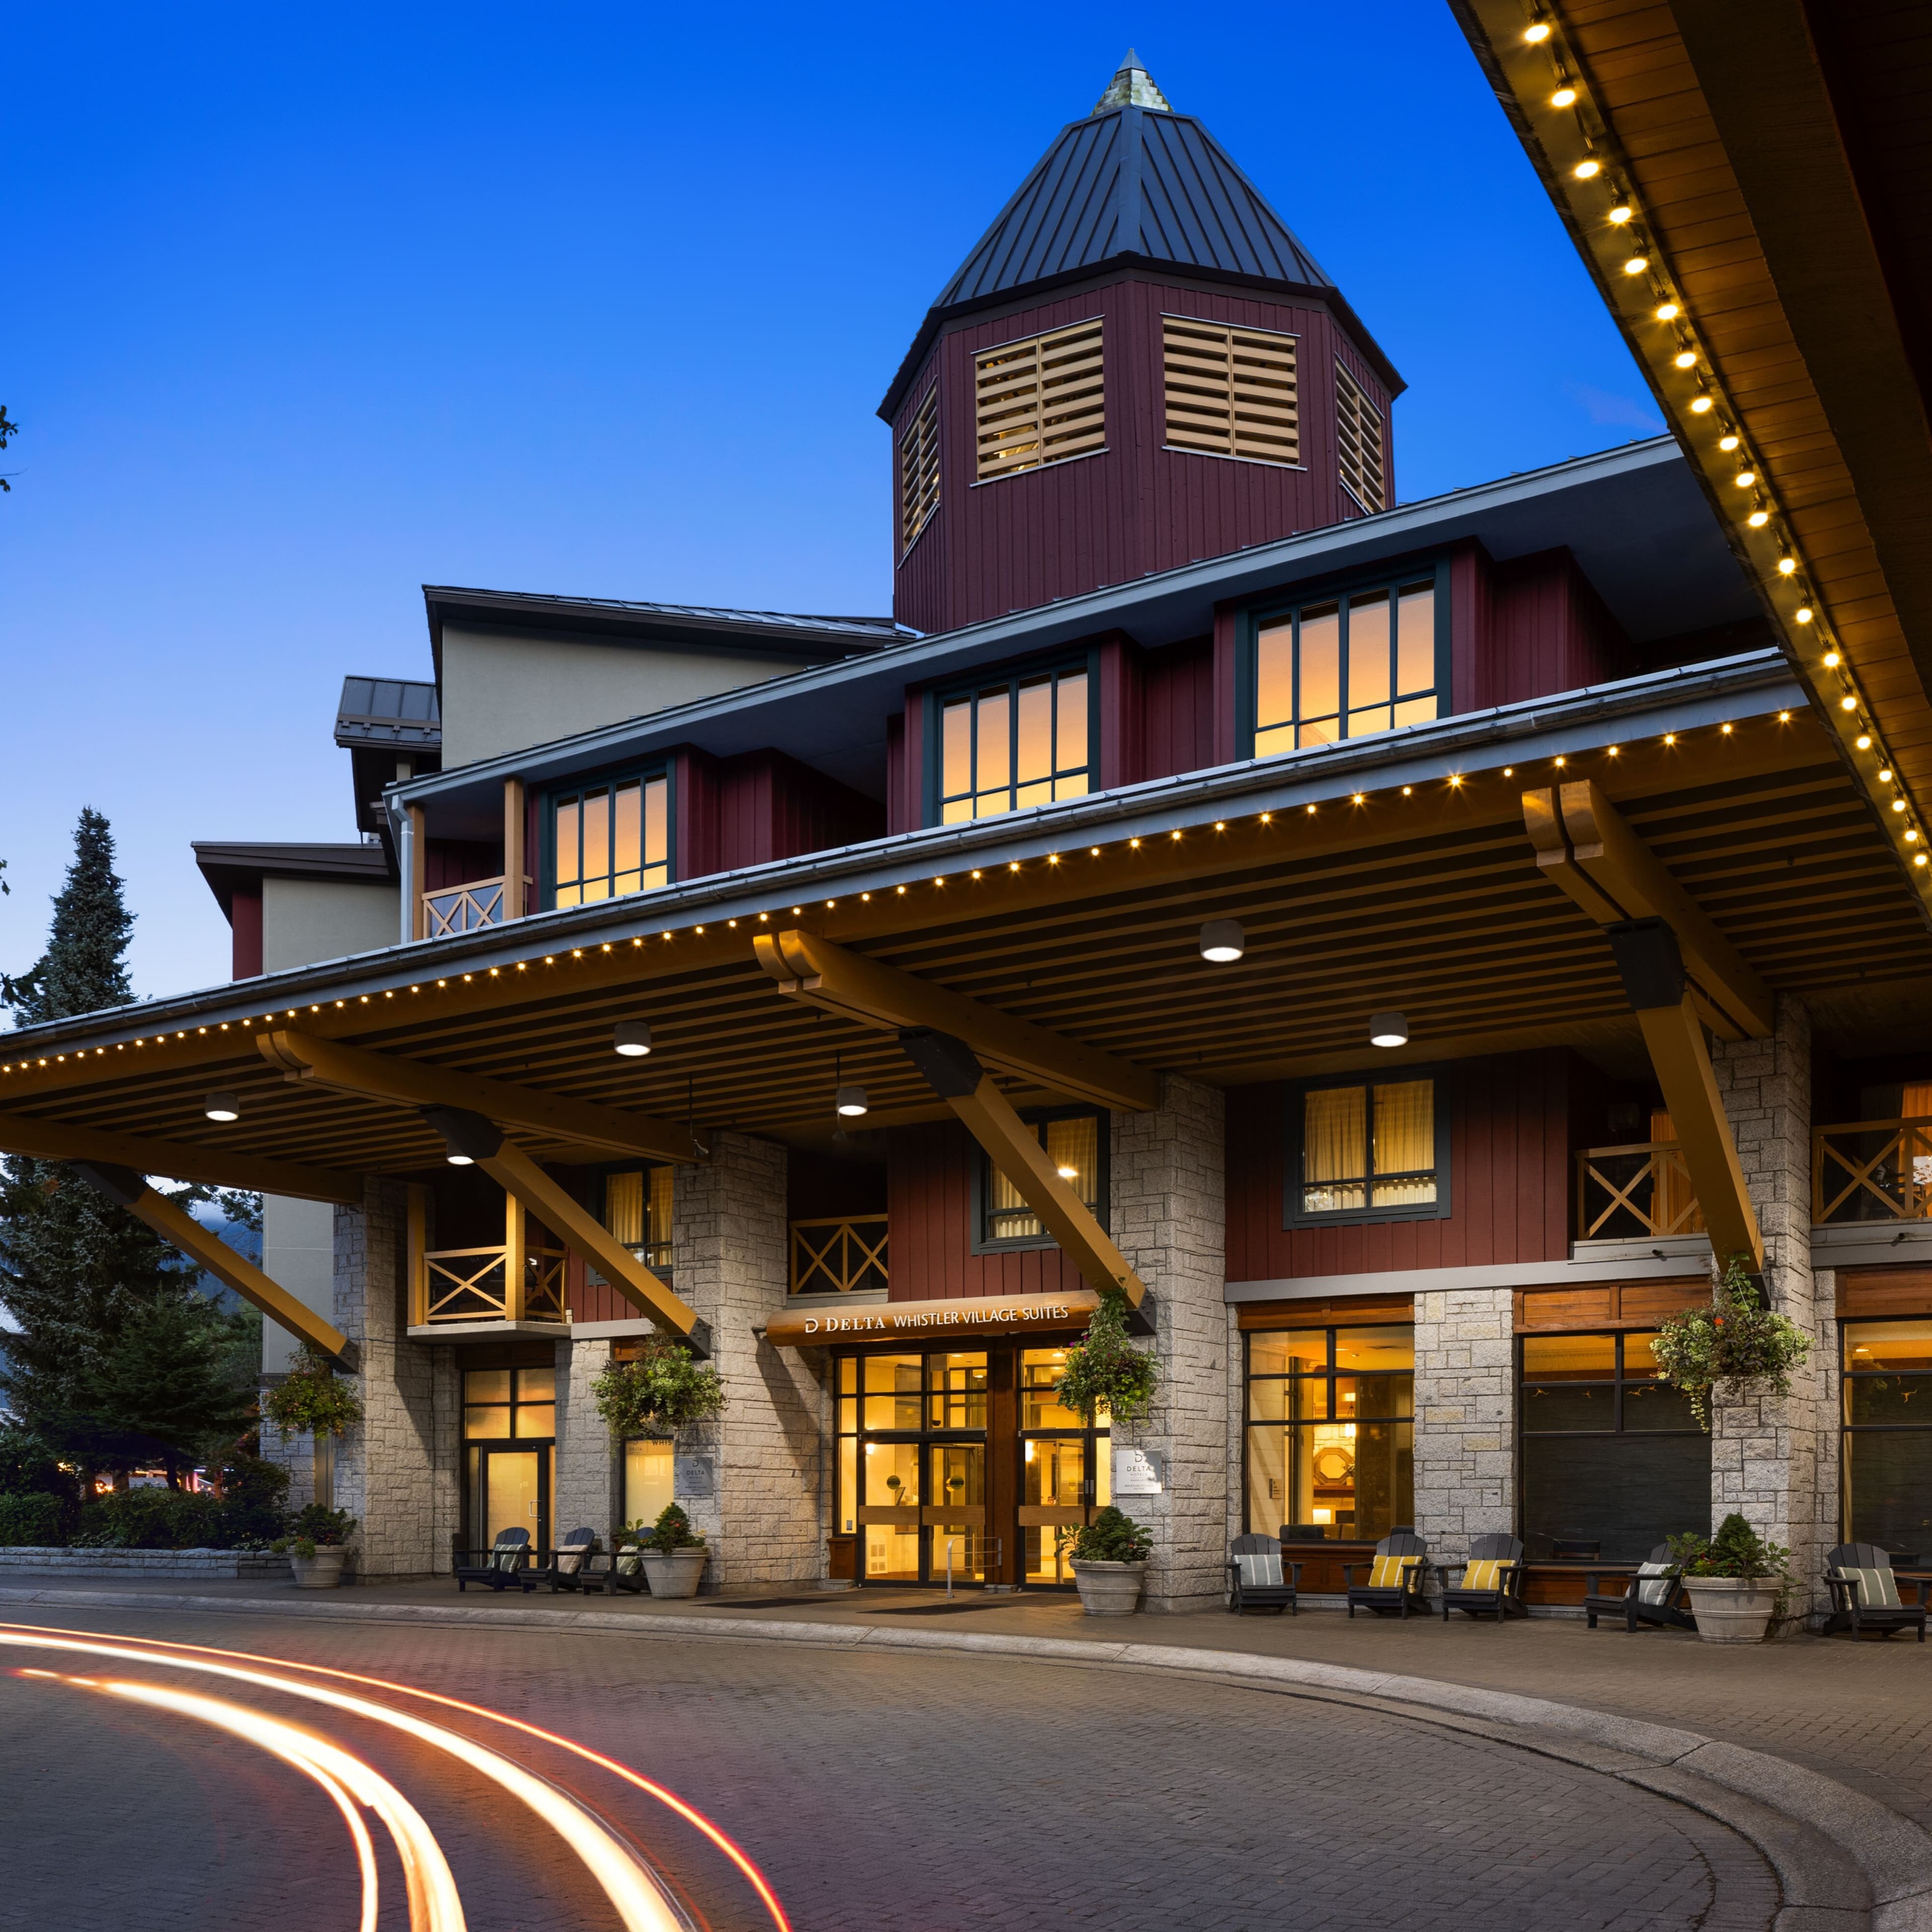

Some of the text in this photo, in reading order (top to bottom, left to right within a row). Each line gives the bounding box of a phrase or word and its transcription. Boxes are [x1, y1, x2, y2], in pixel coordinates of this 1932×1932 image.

[825, 1317, 886, 1331] DELTA
[894, 1312, 959, 1327] WHISTLER
[961, 1309, 1018, 1324] VILLAGE
[1022, 1306, 1069, 1320] SUITES
